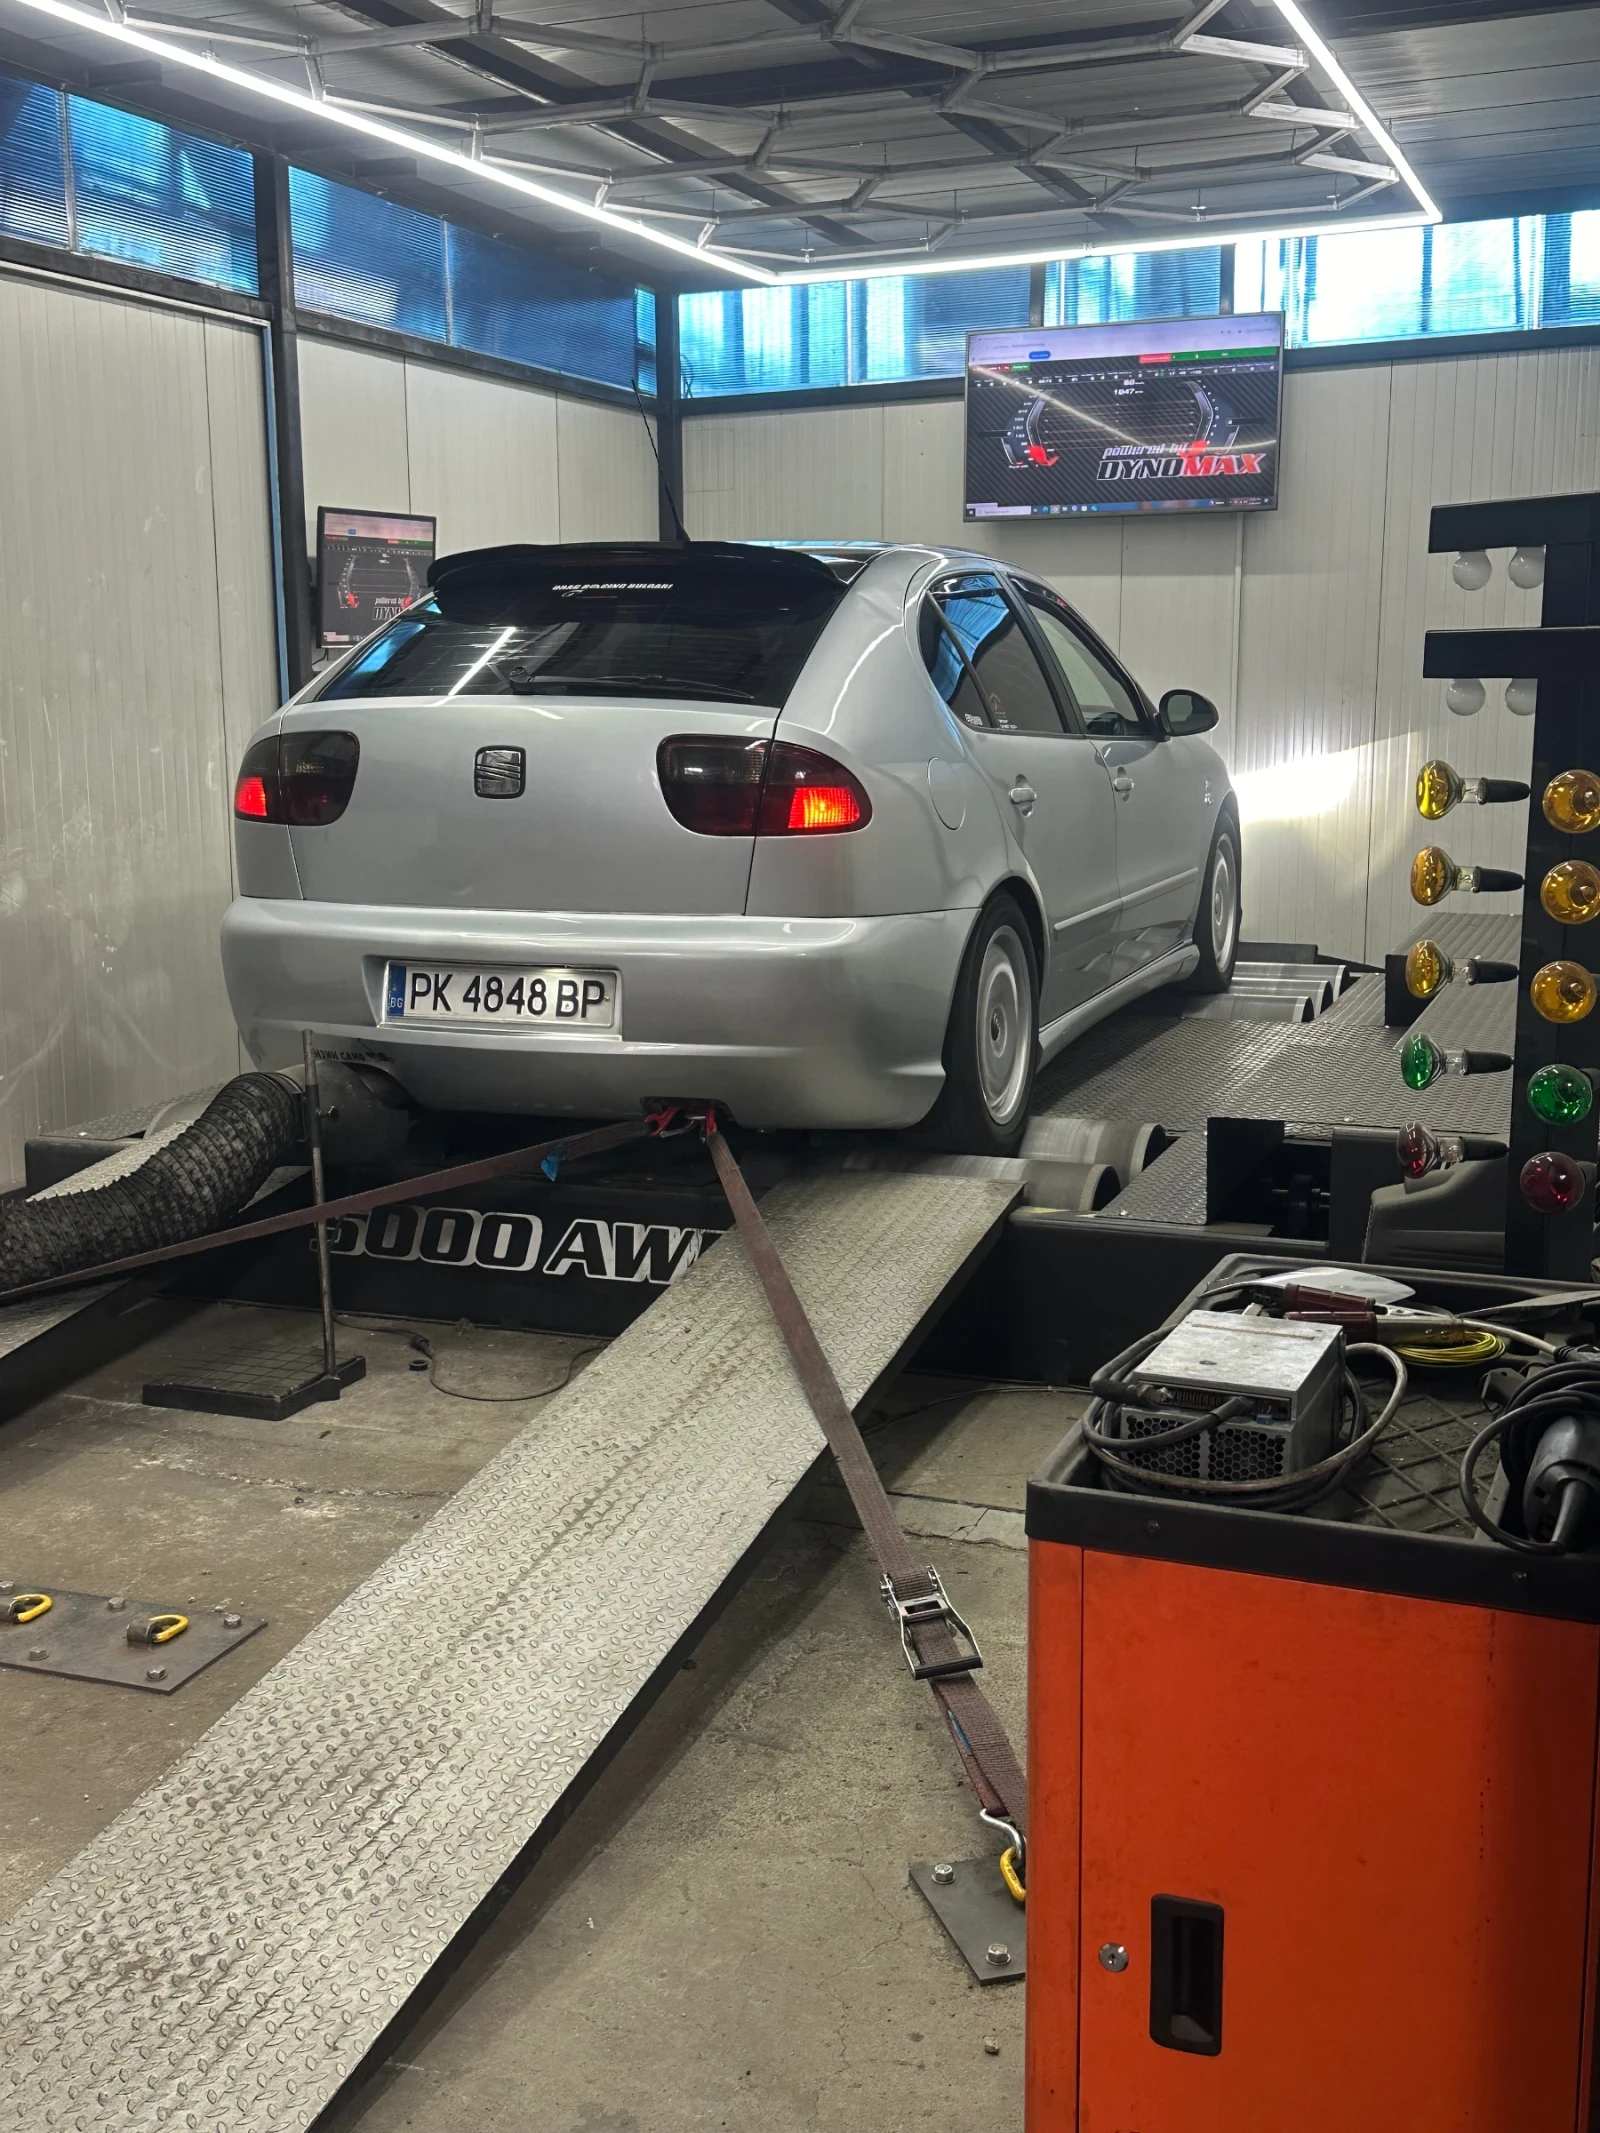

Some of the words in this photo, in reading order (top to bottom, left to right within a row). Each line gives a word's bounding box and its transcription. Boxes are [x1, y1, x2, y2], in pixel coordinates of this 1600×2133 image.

[1102, 444, 1165, 459] powered
[1097, 453, 1266, 480] DYNOMAX
[390, 998, 403, 1008] BG
[410, 972, 454, 1012] PK
[462, 975, 547, 1016] 4848
[555, 980, 605, 1018] BP
